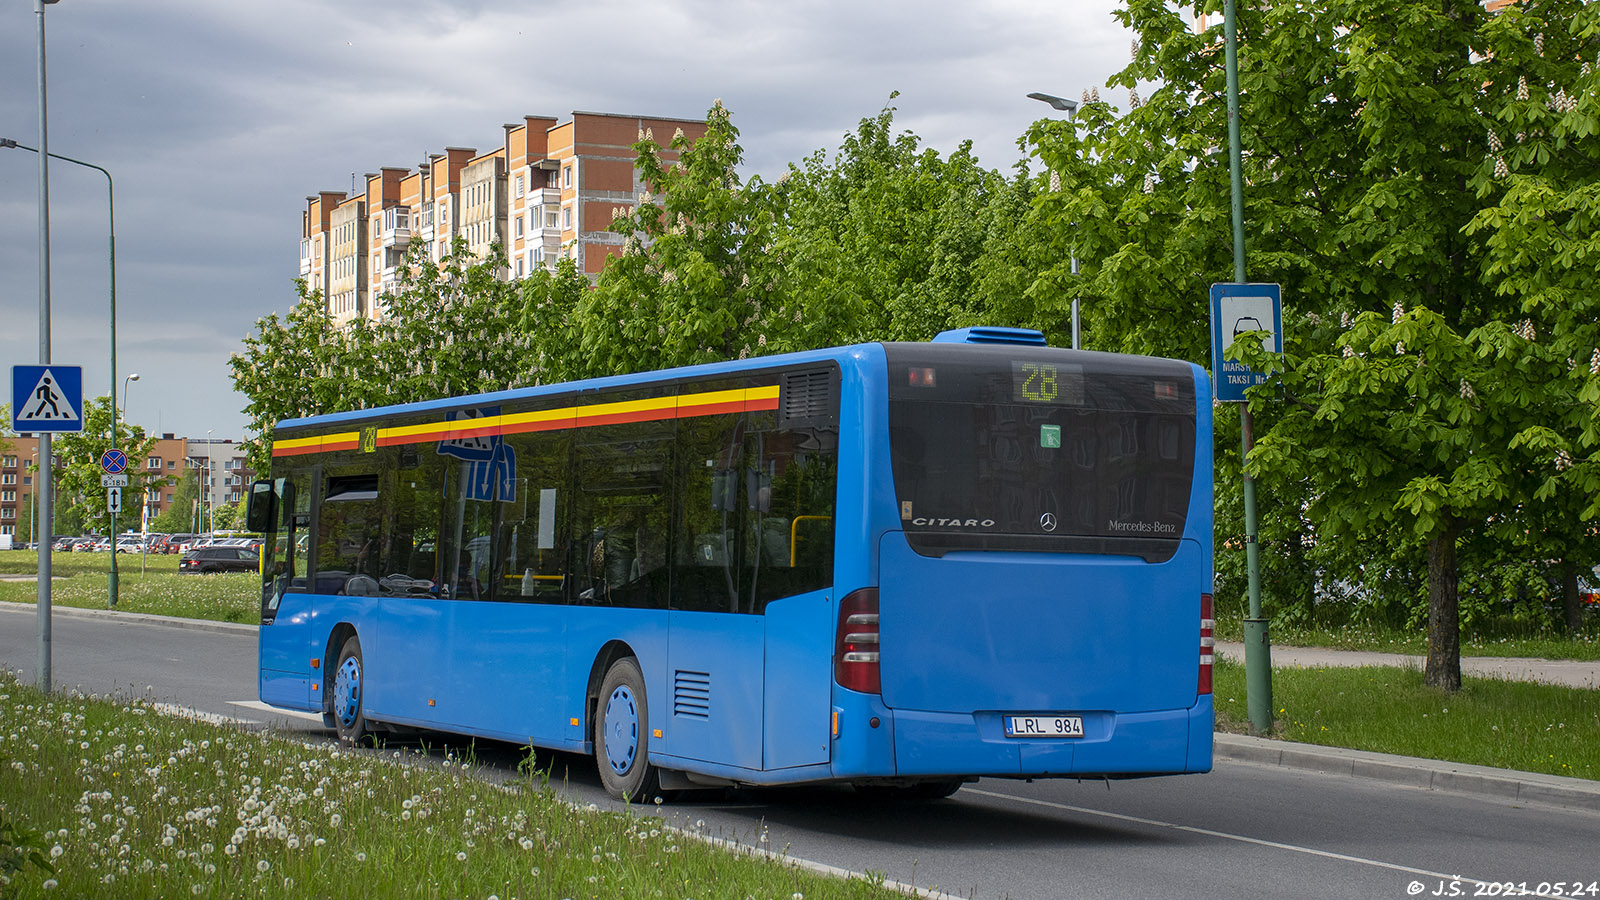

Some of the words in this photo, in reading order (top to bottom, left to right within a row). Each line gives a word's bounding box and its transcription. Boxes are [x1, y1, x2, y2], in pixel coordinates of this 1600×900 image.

[1022, 363, 1058, 401] 28
[1227, 375, 1250, 384] TAKSI
[364, 426, 376, 453] 28
[912, 517, 995, 527] CITARO
[1108, 520, 1176, 533] Mercedes-Benz
[1014, 718, 1046, 733] LRL
[1055, 719, 1080, 733] 984
